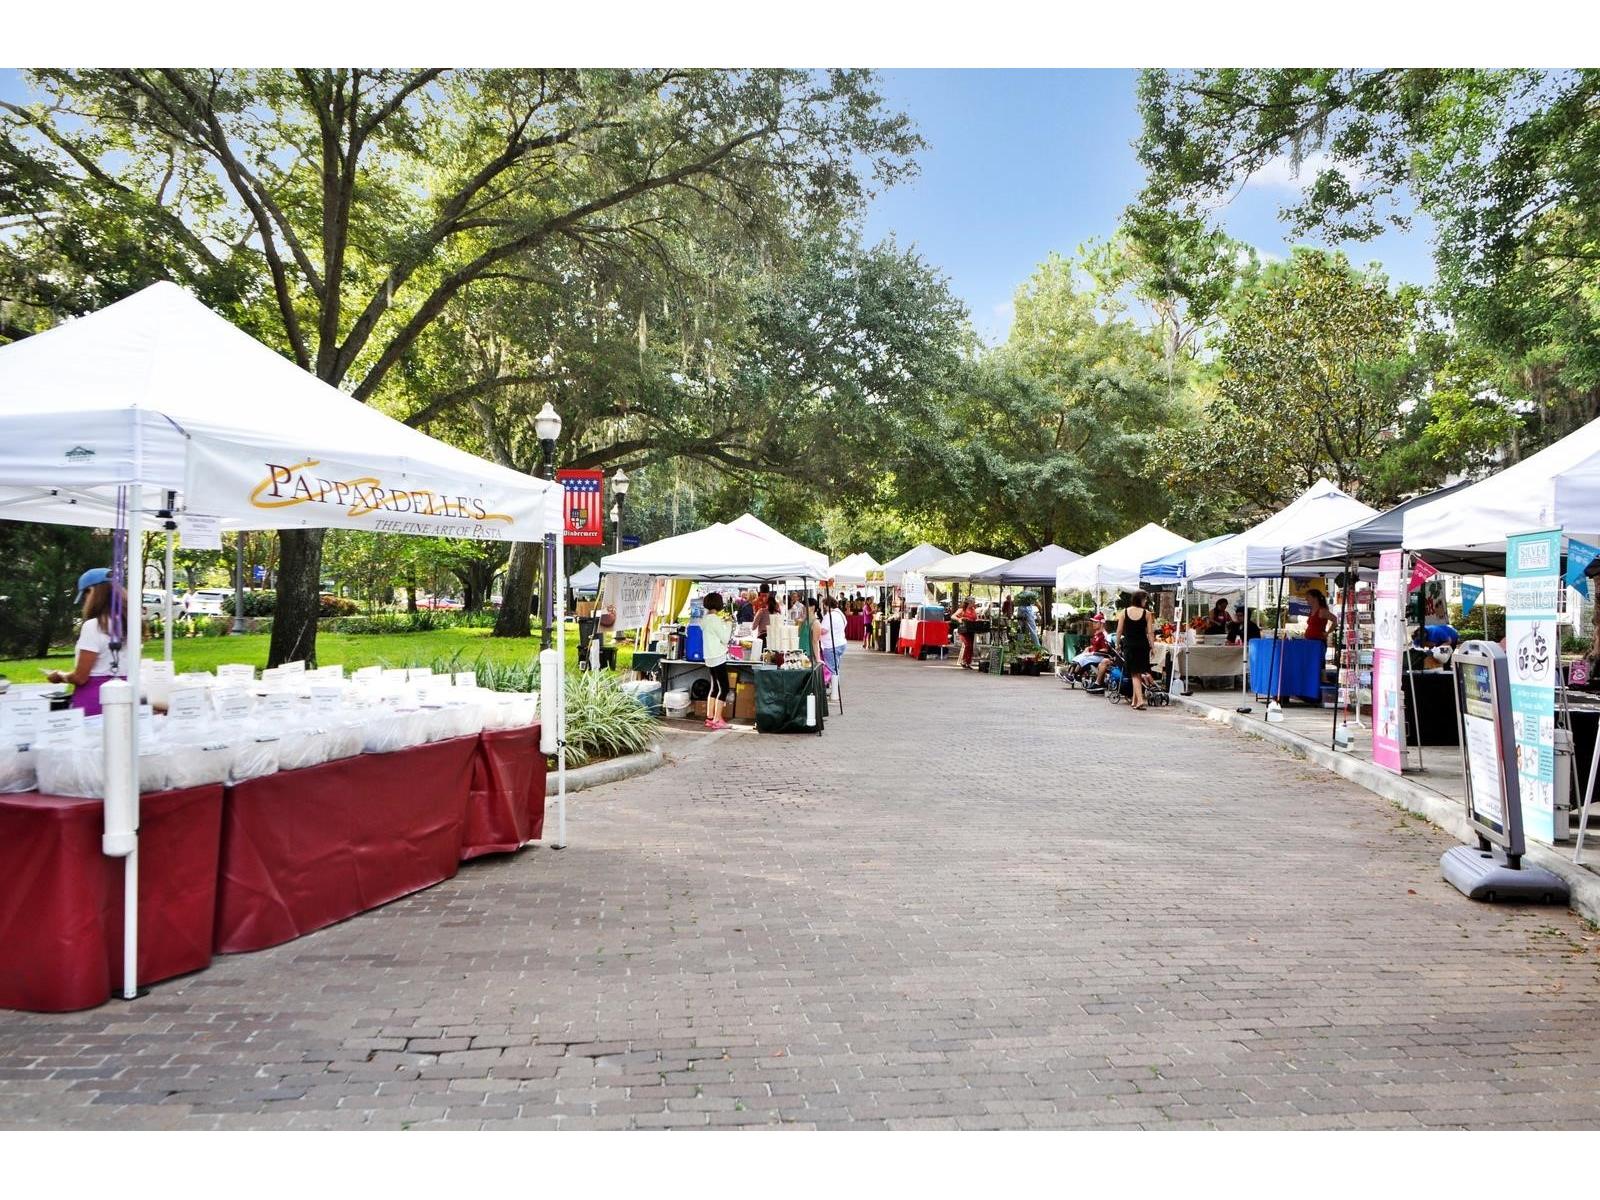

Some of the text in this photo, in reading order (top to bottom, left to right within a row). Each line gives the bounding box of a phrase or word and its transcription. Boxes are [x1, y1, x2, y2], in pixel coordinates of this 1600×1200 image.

[265, 463, 486, 520] PAPPARDELLE'S
[375, 519, 501, 539] THE FINE ART OF PASTA
